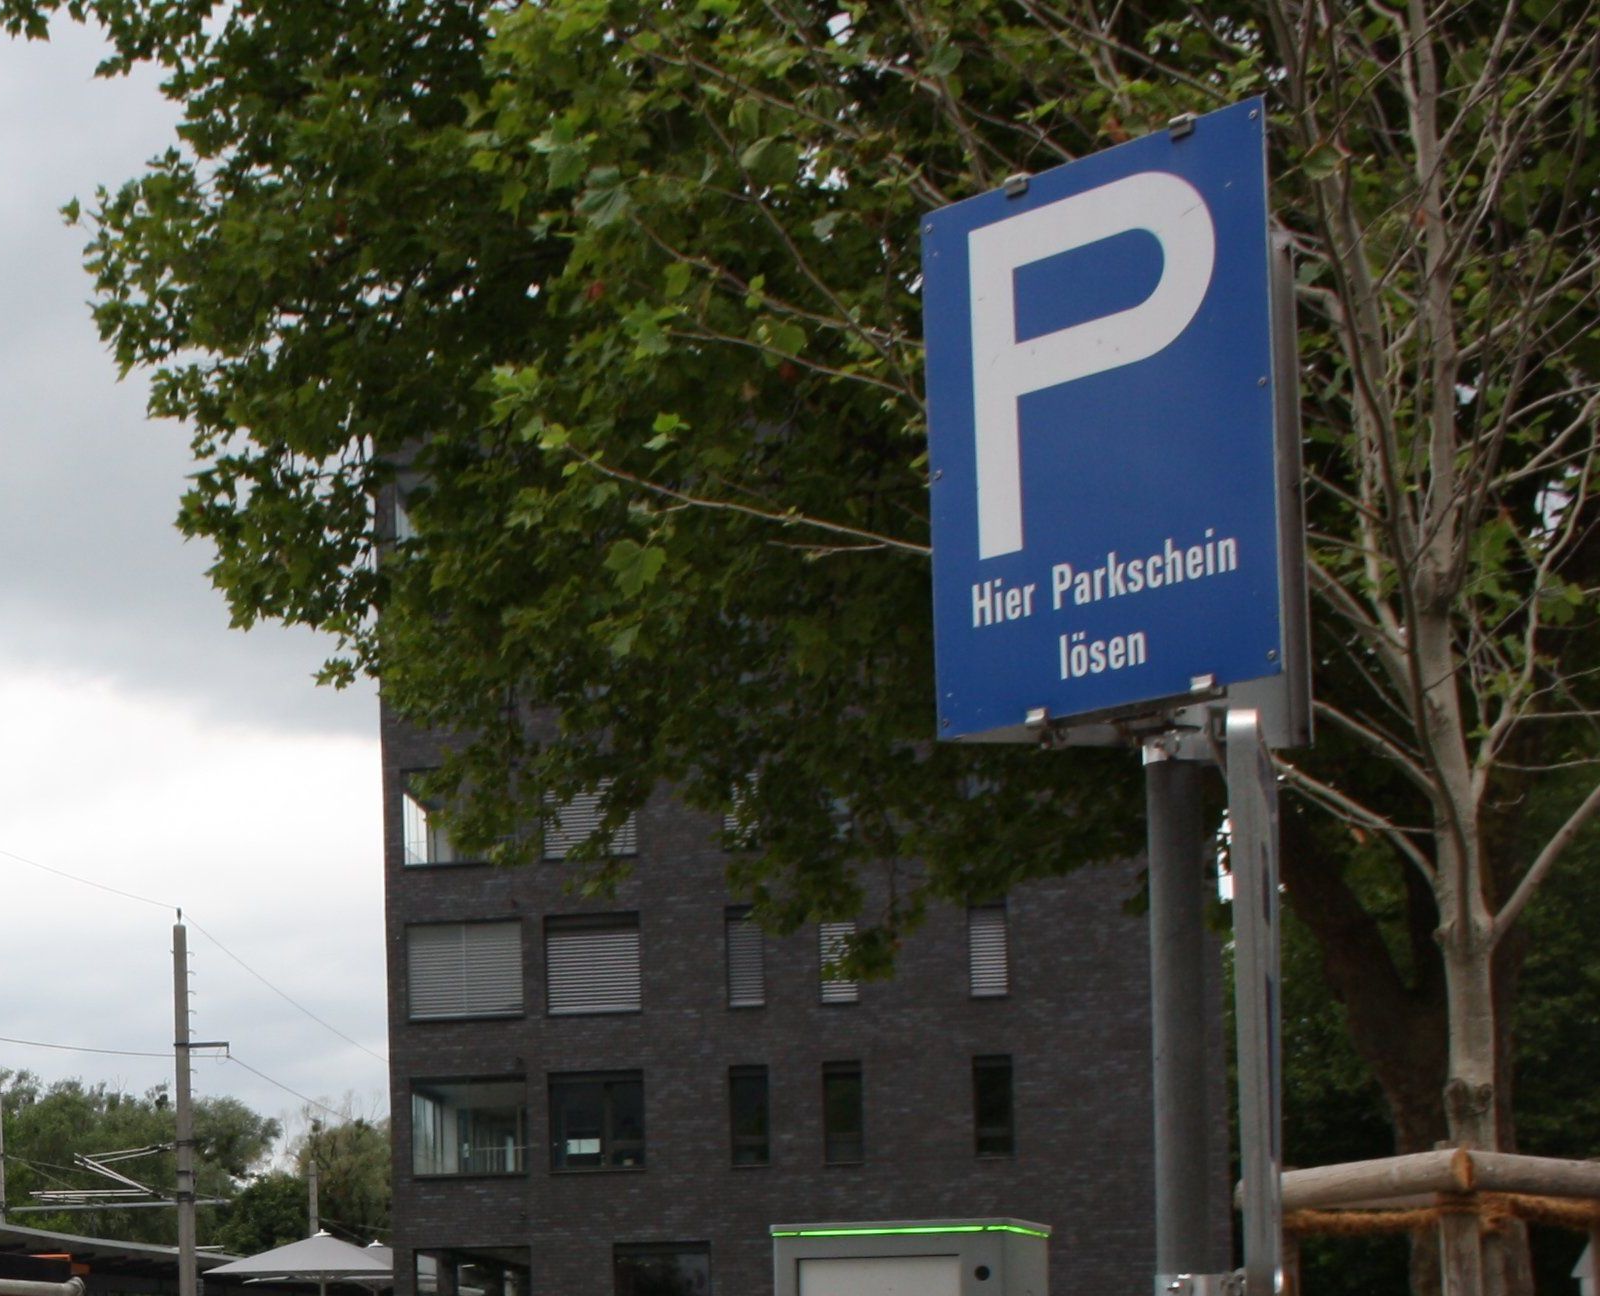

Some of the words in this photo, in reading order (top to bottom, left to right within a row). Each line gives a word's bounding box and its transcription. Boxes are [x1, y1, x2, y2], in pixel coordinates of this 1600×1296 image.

[968, 171, 1216, 561] P
[971, 578, 1036, 628] Hier
[1052, 528, 1238, 610] Parkschein
[1059, 630, 1147, 680] lösen
